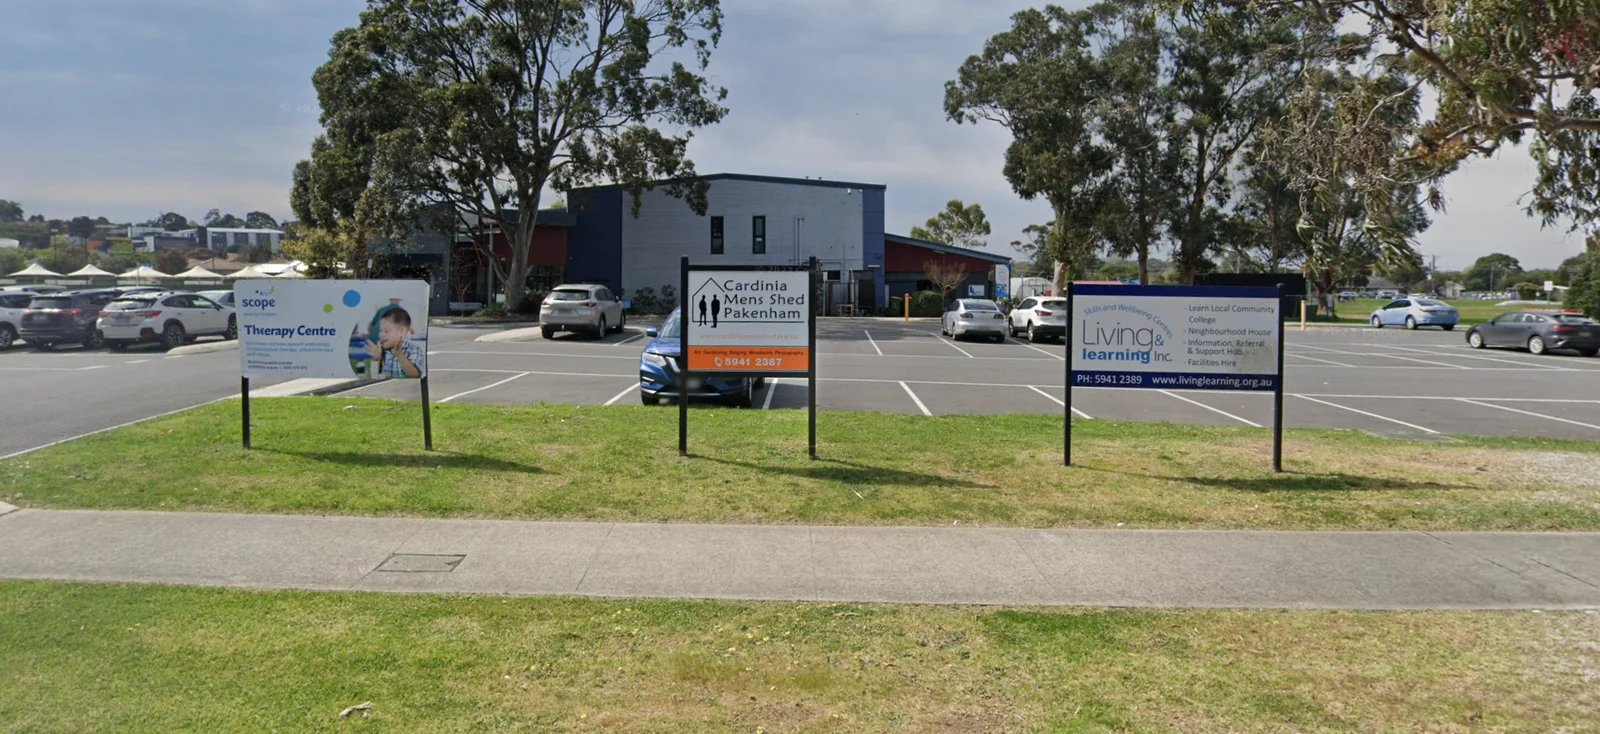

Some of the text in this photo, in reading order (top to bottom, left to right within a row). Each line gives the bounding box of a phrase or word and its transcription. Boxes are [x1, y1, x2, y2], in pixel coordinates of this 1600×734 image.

[724, 280, 787, 292] Cardinia
[242, 299, 275, 310] scope
[724, 294, 804, 305] Mens Shed
[724, 308, 800, 318] Pakenham
[1188, 304, 1275, 314] Learn Local Community
[1083, 305, 1102, 316] Skills
[1118, 304, 1152, 320] Wellbeing
[1152, 316, 1173, 338] Centres
[1188, 316, 1216, 324] College
[297, 325, 336, 336] Centre
[1188, 328, 1246, 336] Neighbourhood
[1082, 320, 1164, 353] Living &
[1188, 339, 1234, 348] Information,
[1082, 348, 1172, 364] learning Inc.
[1195, 348, 1226, 356] Support
[725, 358, 782, 366] 5941 2387
[1077, 374, 1272, 388] PH: 5941 2389 www.livinglearning.org.au
